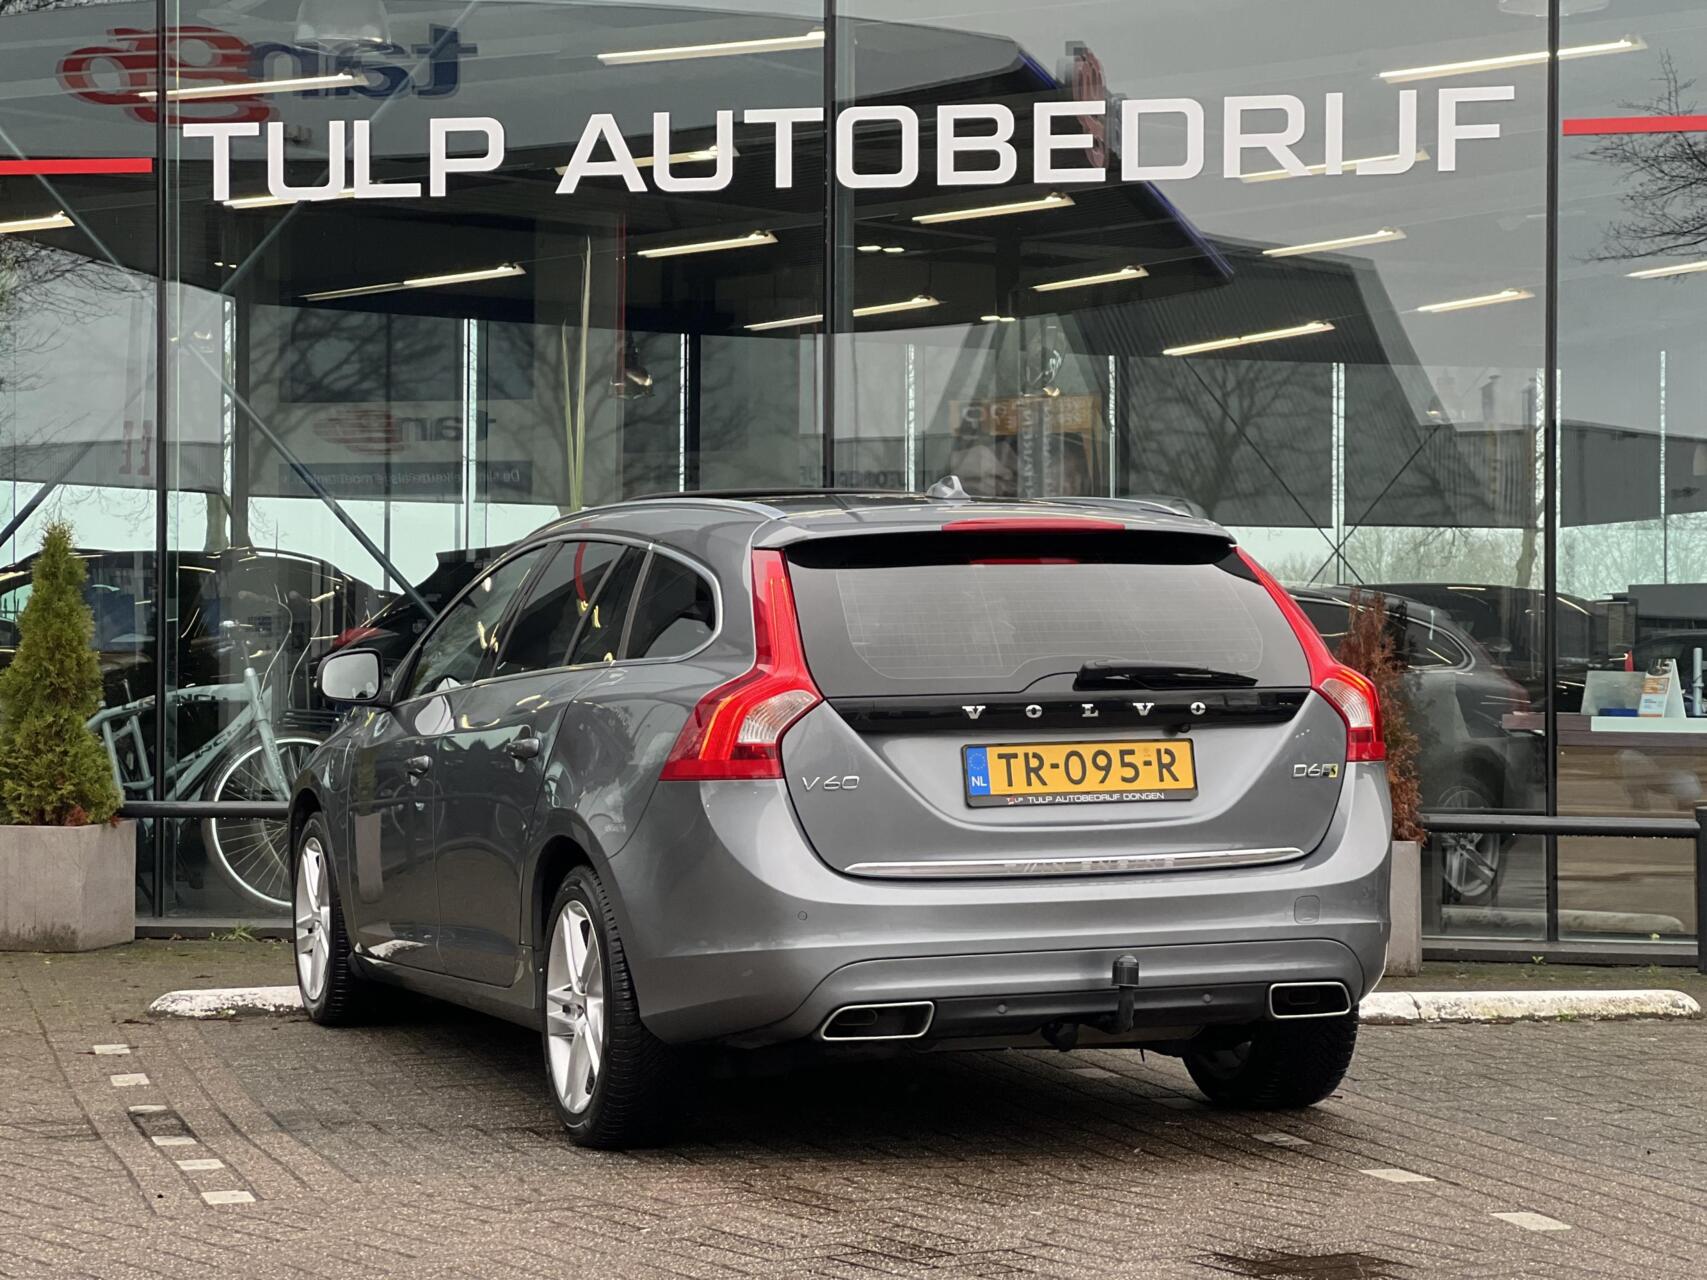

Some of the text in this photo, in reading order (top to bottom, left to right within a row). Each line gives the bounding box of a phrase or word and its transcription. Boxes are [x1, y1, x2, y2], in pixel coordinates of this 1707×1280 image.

[182, 84, 1516, 201] TULP AUTOBEDRIJF
[961, 701, 1206, 720] VOLVO
[971, 747, 1180, 788] NL TR-095-R
[801, 775, 860, 791] V60
[1027, 796, 1053, 804] TULP
[1055, 793, 1120, 802] AUTOBEDRIJF
[1123, 792, 1165, 800] DONGEN
